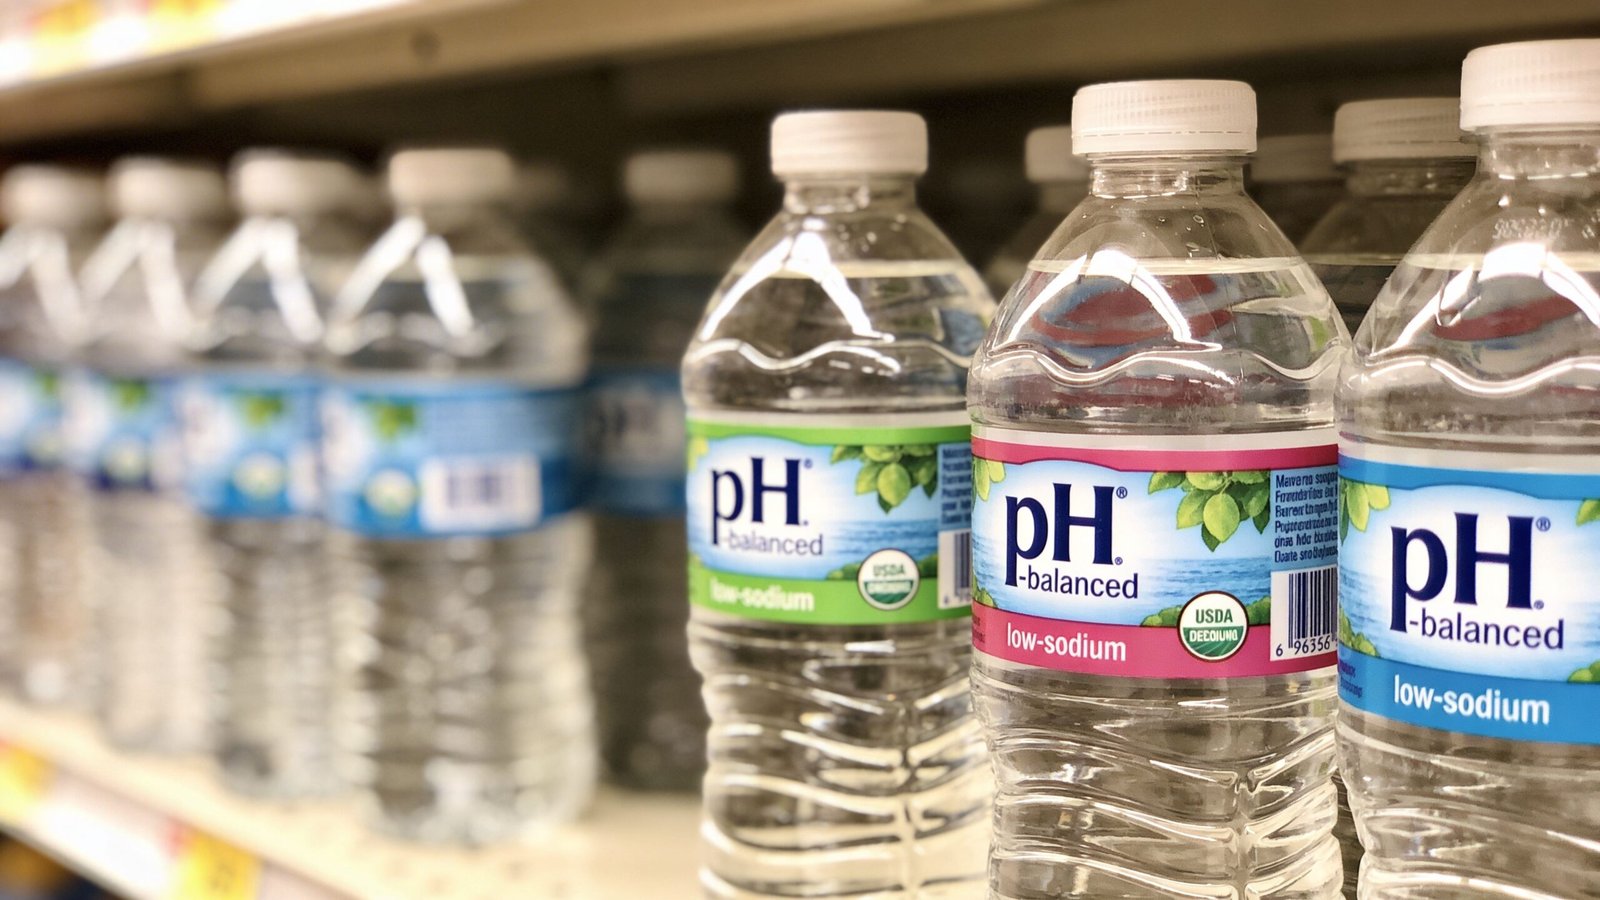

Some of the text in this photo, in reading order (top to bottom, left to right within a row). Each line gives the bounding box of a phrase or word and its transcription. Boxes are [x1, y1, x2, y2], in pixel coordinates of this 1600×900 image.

[1195, 608, 1233, 624] USDA
[1007, 622, 1126, 661] low-sodium
[1275, 643, 1284, 657] 6
[1394, 674, 1550, 725] low-sodium
